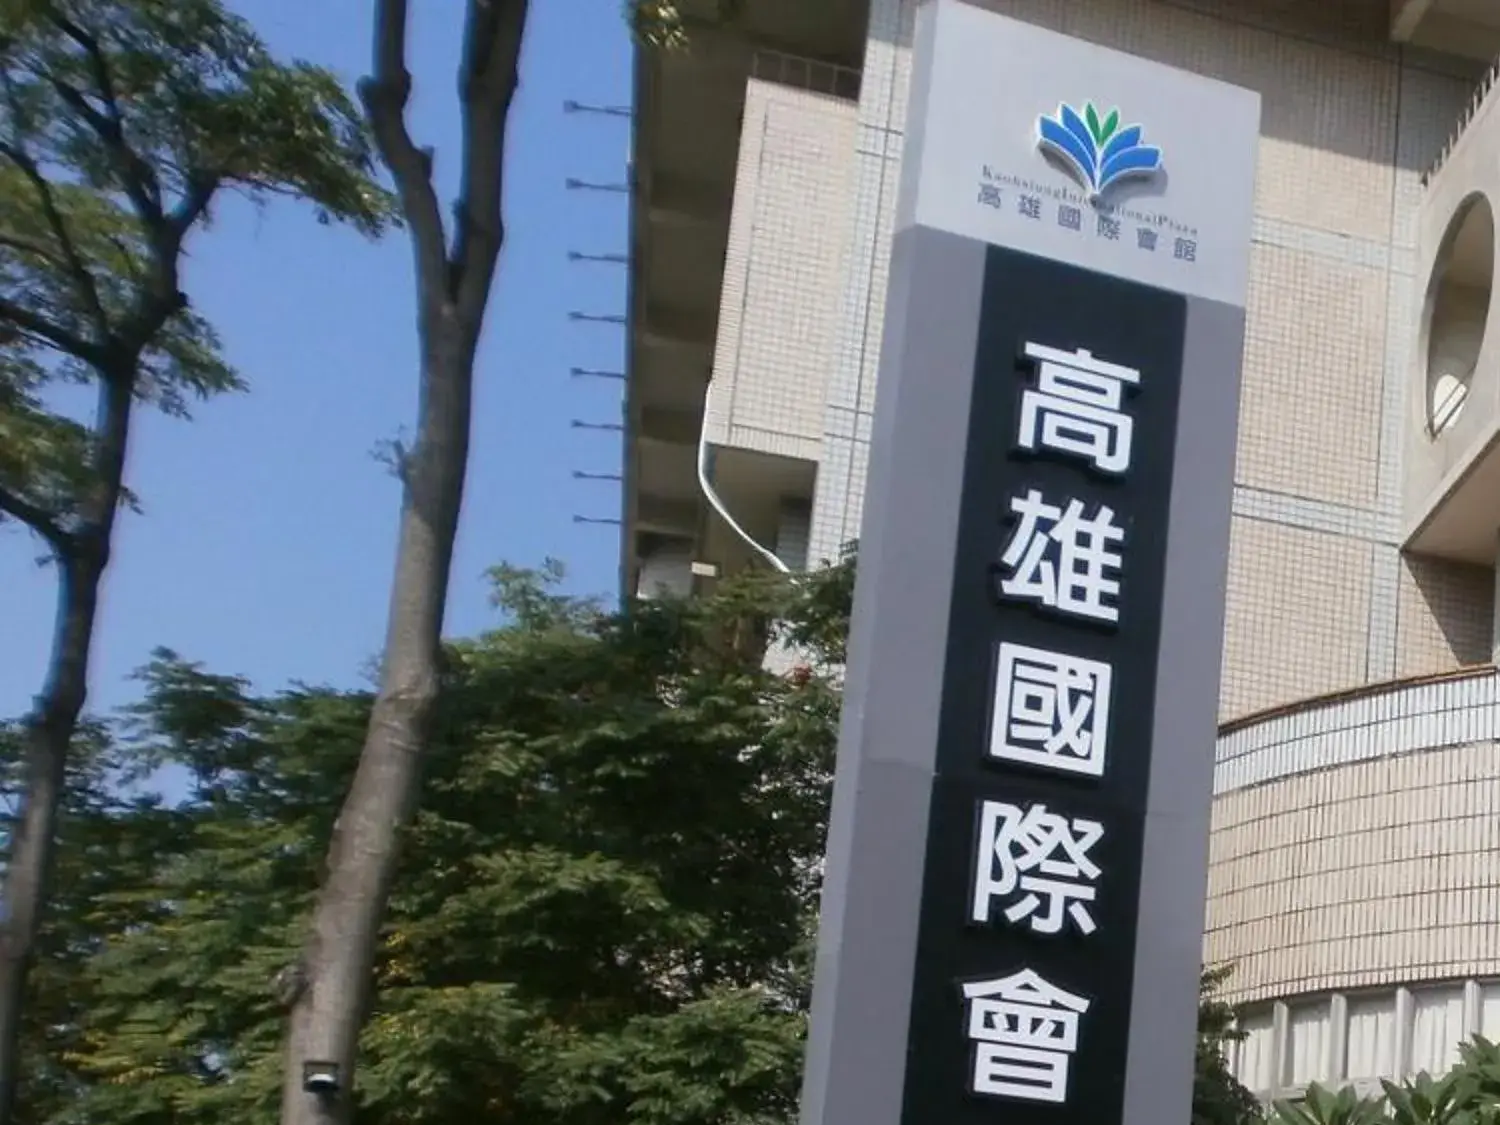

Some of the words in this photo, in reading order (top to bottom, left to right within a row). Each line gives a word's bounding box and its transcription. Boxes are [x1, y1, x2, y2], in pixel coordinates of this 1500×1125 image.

[977, 182, 1197, 262] 高雄國際會館
